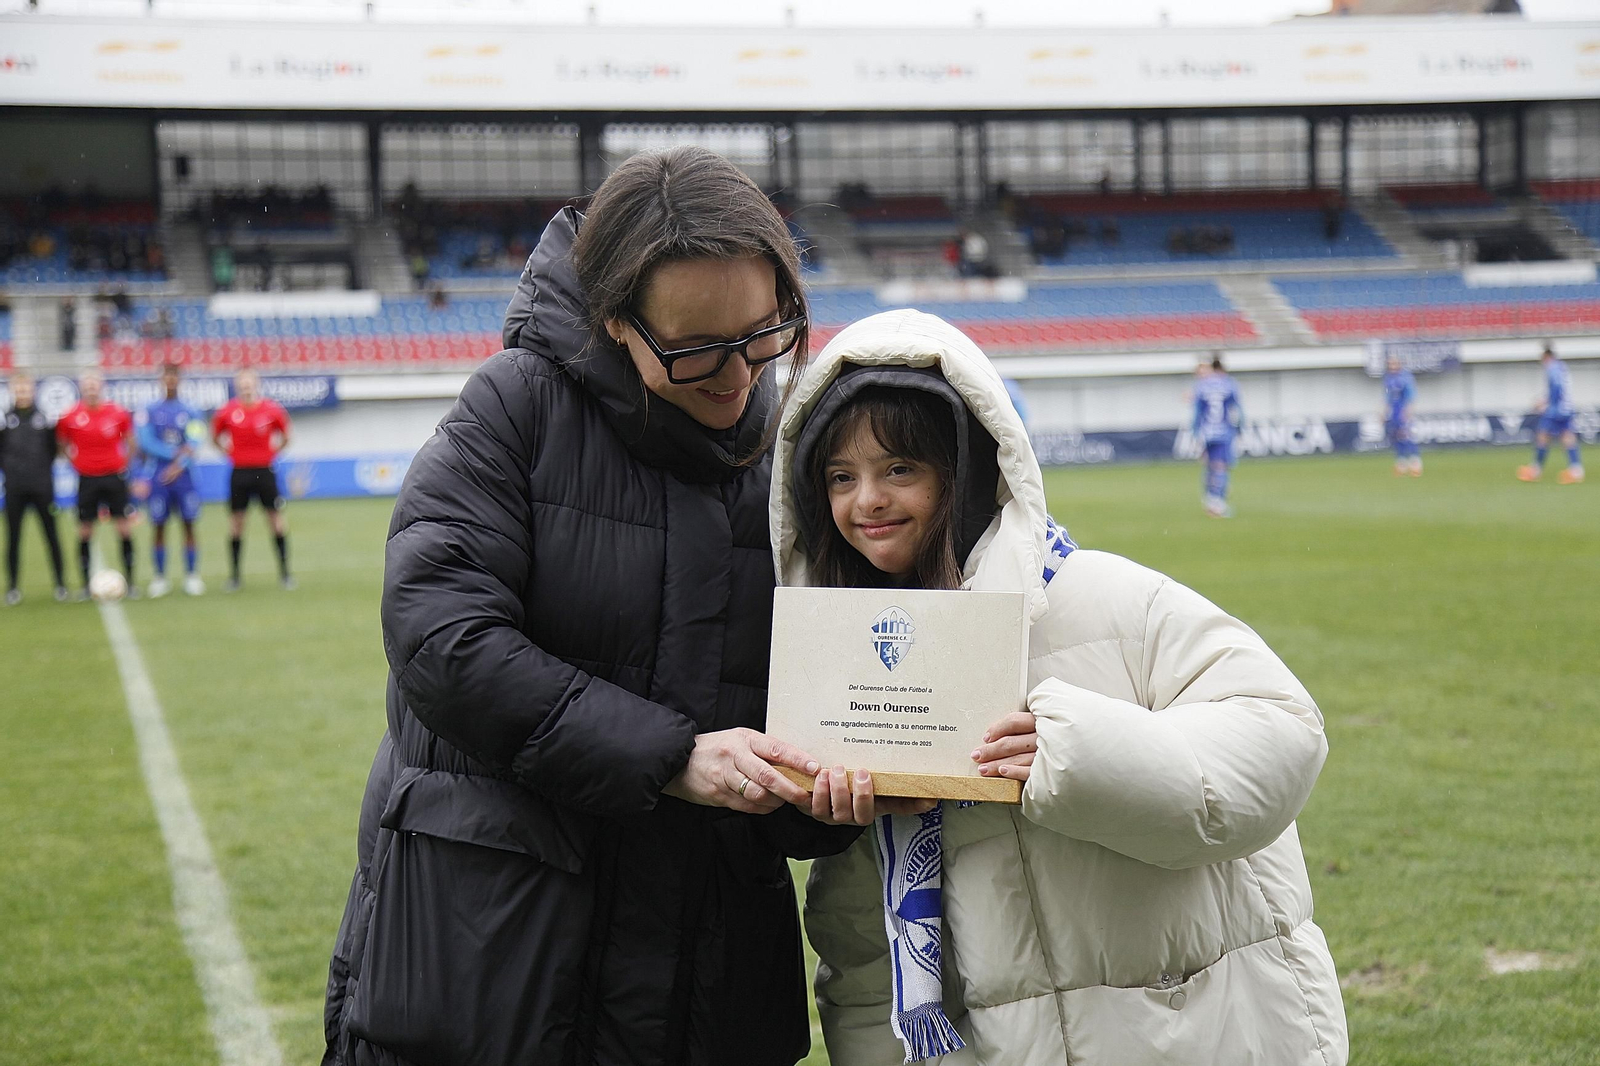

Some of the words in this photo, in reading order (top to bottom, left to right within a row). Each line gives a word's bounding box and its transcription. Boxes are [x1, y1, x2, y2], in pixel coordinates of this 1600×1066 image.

[1173, 422, 1334, 460] AANCA
[859, 684, 884, 692] Ourense
[908, 686, 928, 694] Fútbol
[849, 701, 881, 712] Down
[883, 702, 930, 714] Ourense
[840, 720, 894, 729] agradecimiento
[938, 724, 958, 732] labor.
[851, 737, 874, 745] Ourense,
